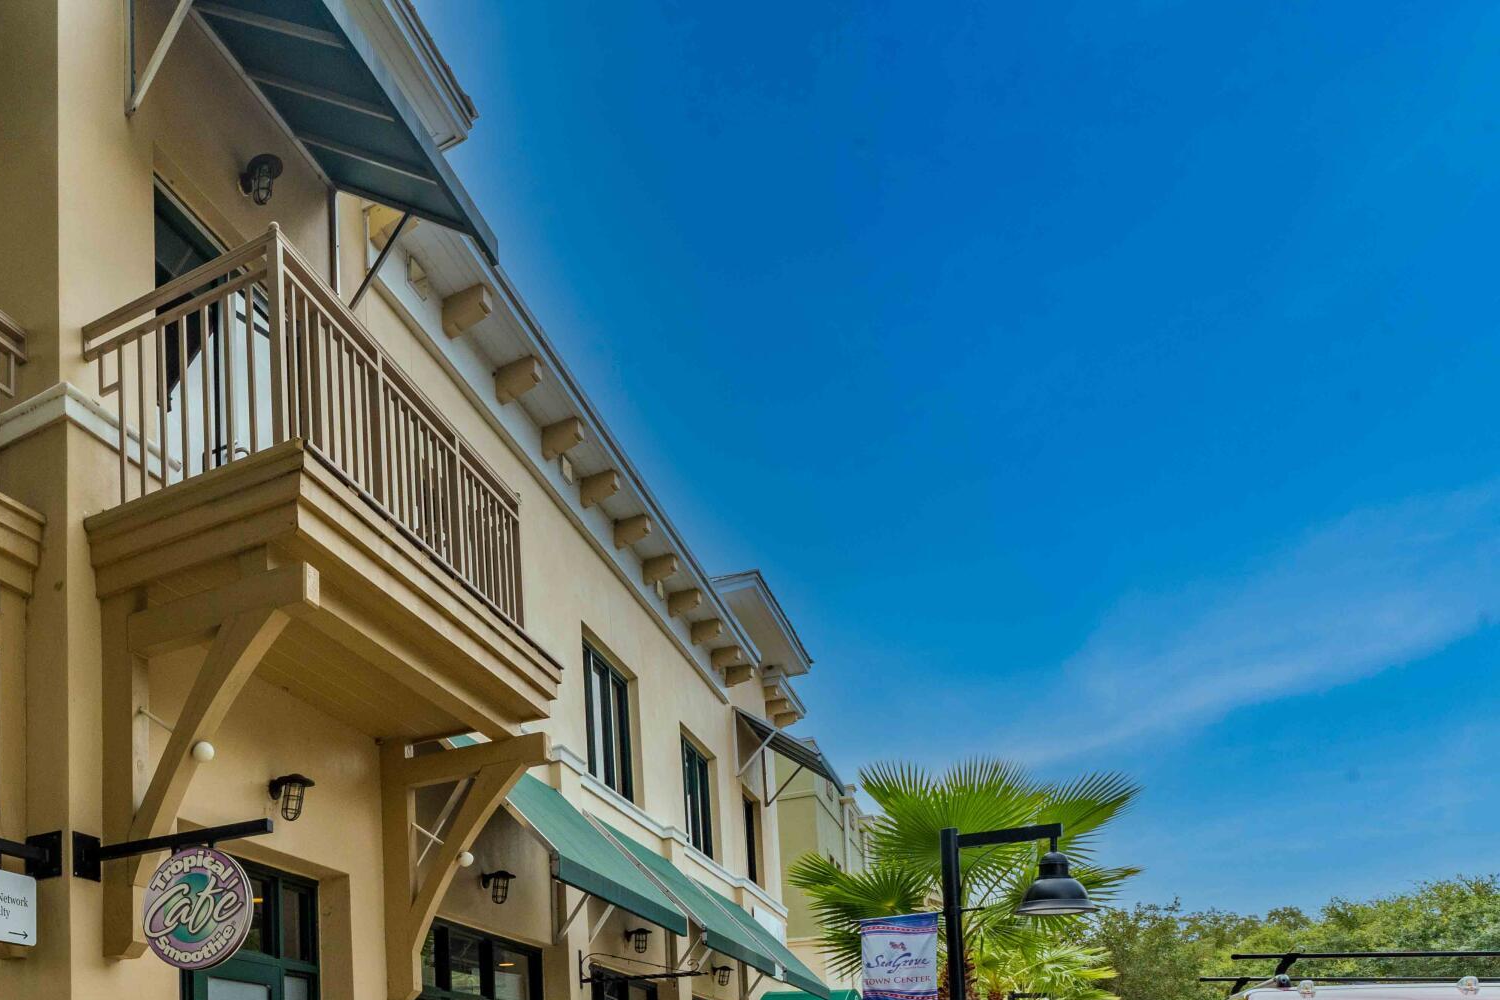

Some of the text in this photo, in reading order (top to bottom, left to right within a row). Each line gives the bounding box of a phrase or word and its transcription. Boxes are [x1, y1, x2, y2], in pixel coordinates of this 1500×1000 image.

[150, 850, 235, 892] Tropical
[144, 876, 245, 938] Café
[865, 975, 932, 986] TOWN CENTER
